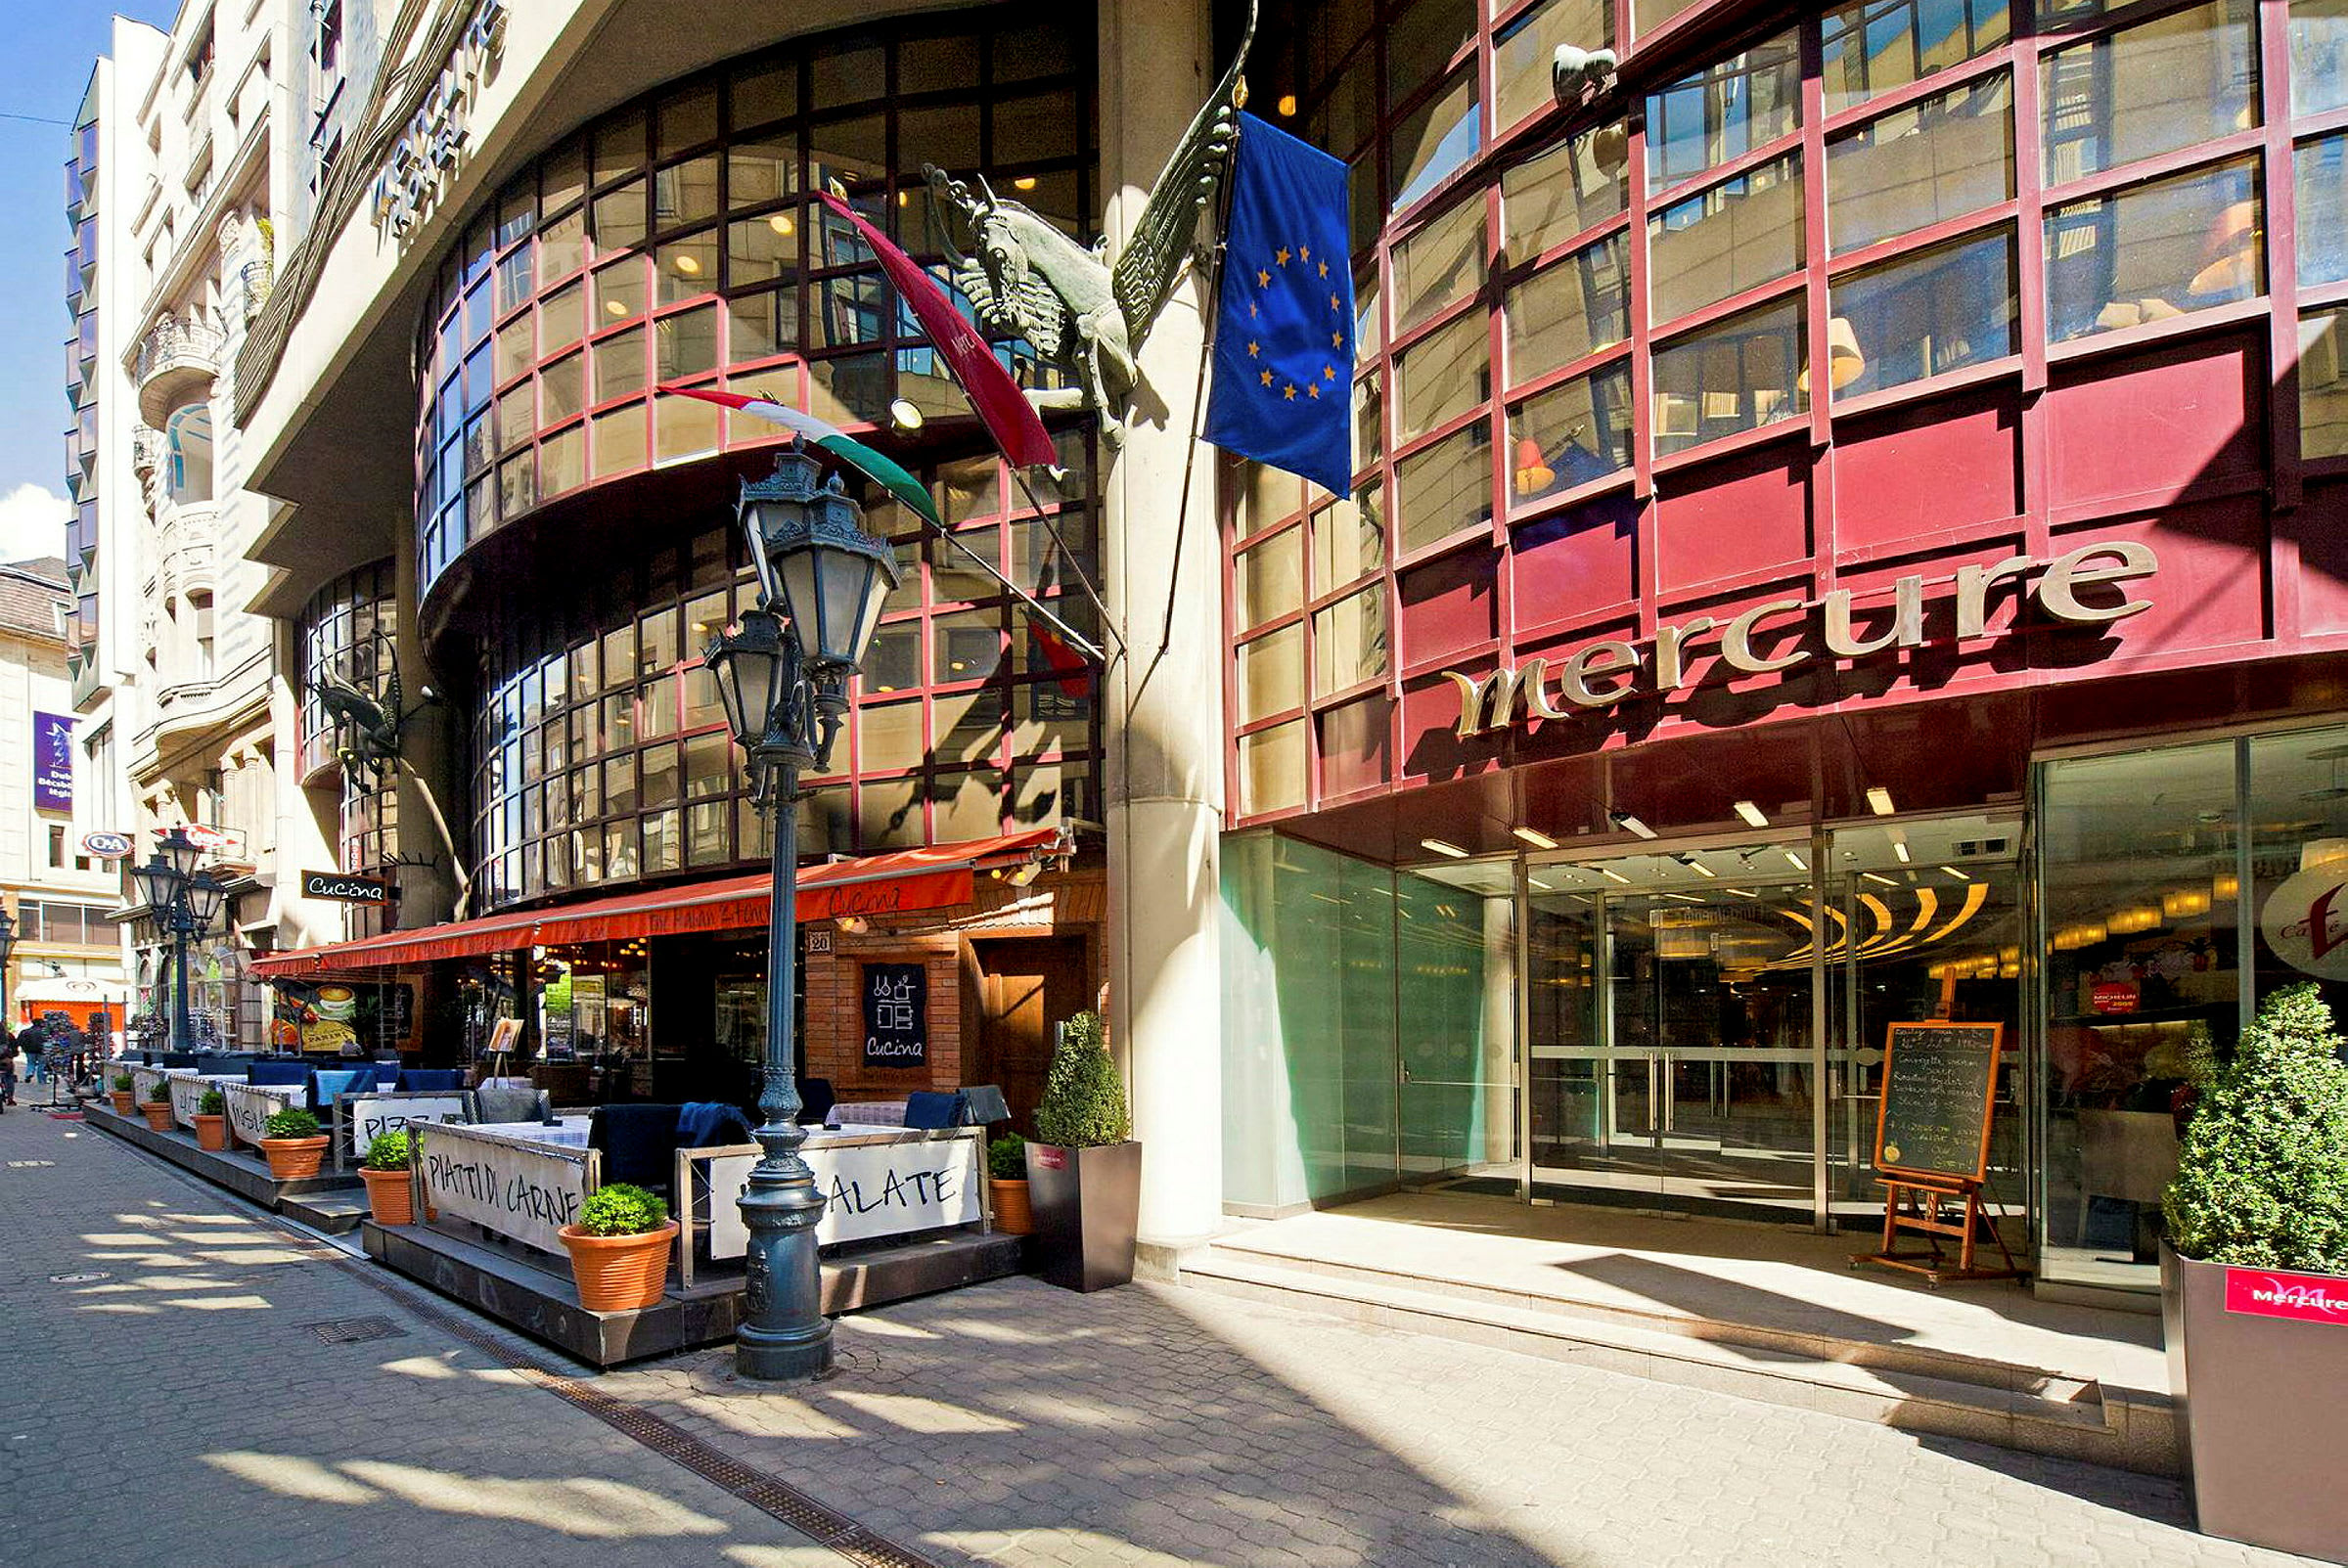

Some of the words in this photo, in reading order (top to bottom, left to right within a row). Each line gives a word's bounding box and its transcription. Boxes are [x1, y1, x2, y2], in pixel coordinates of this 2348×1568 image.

[1441, 541, 2159, 737] mercure
[309, 877, 383, 900] Cucina
[812, 937, 828, 950] 20
[867, 1037, 923, 1056] Cucina
[429, 1153, 483, 1202] PIATTI
[2253, 1289, 2348, 1311] Mercure
